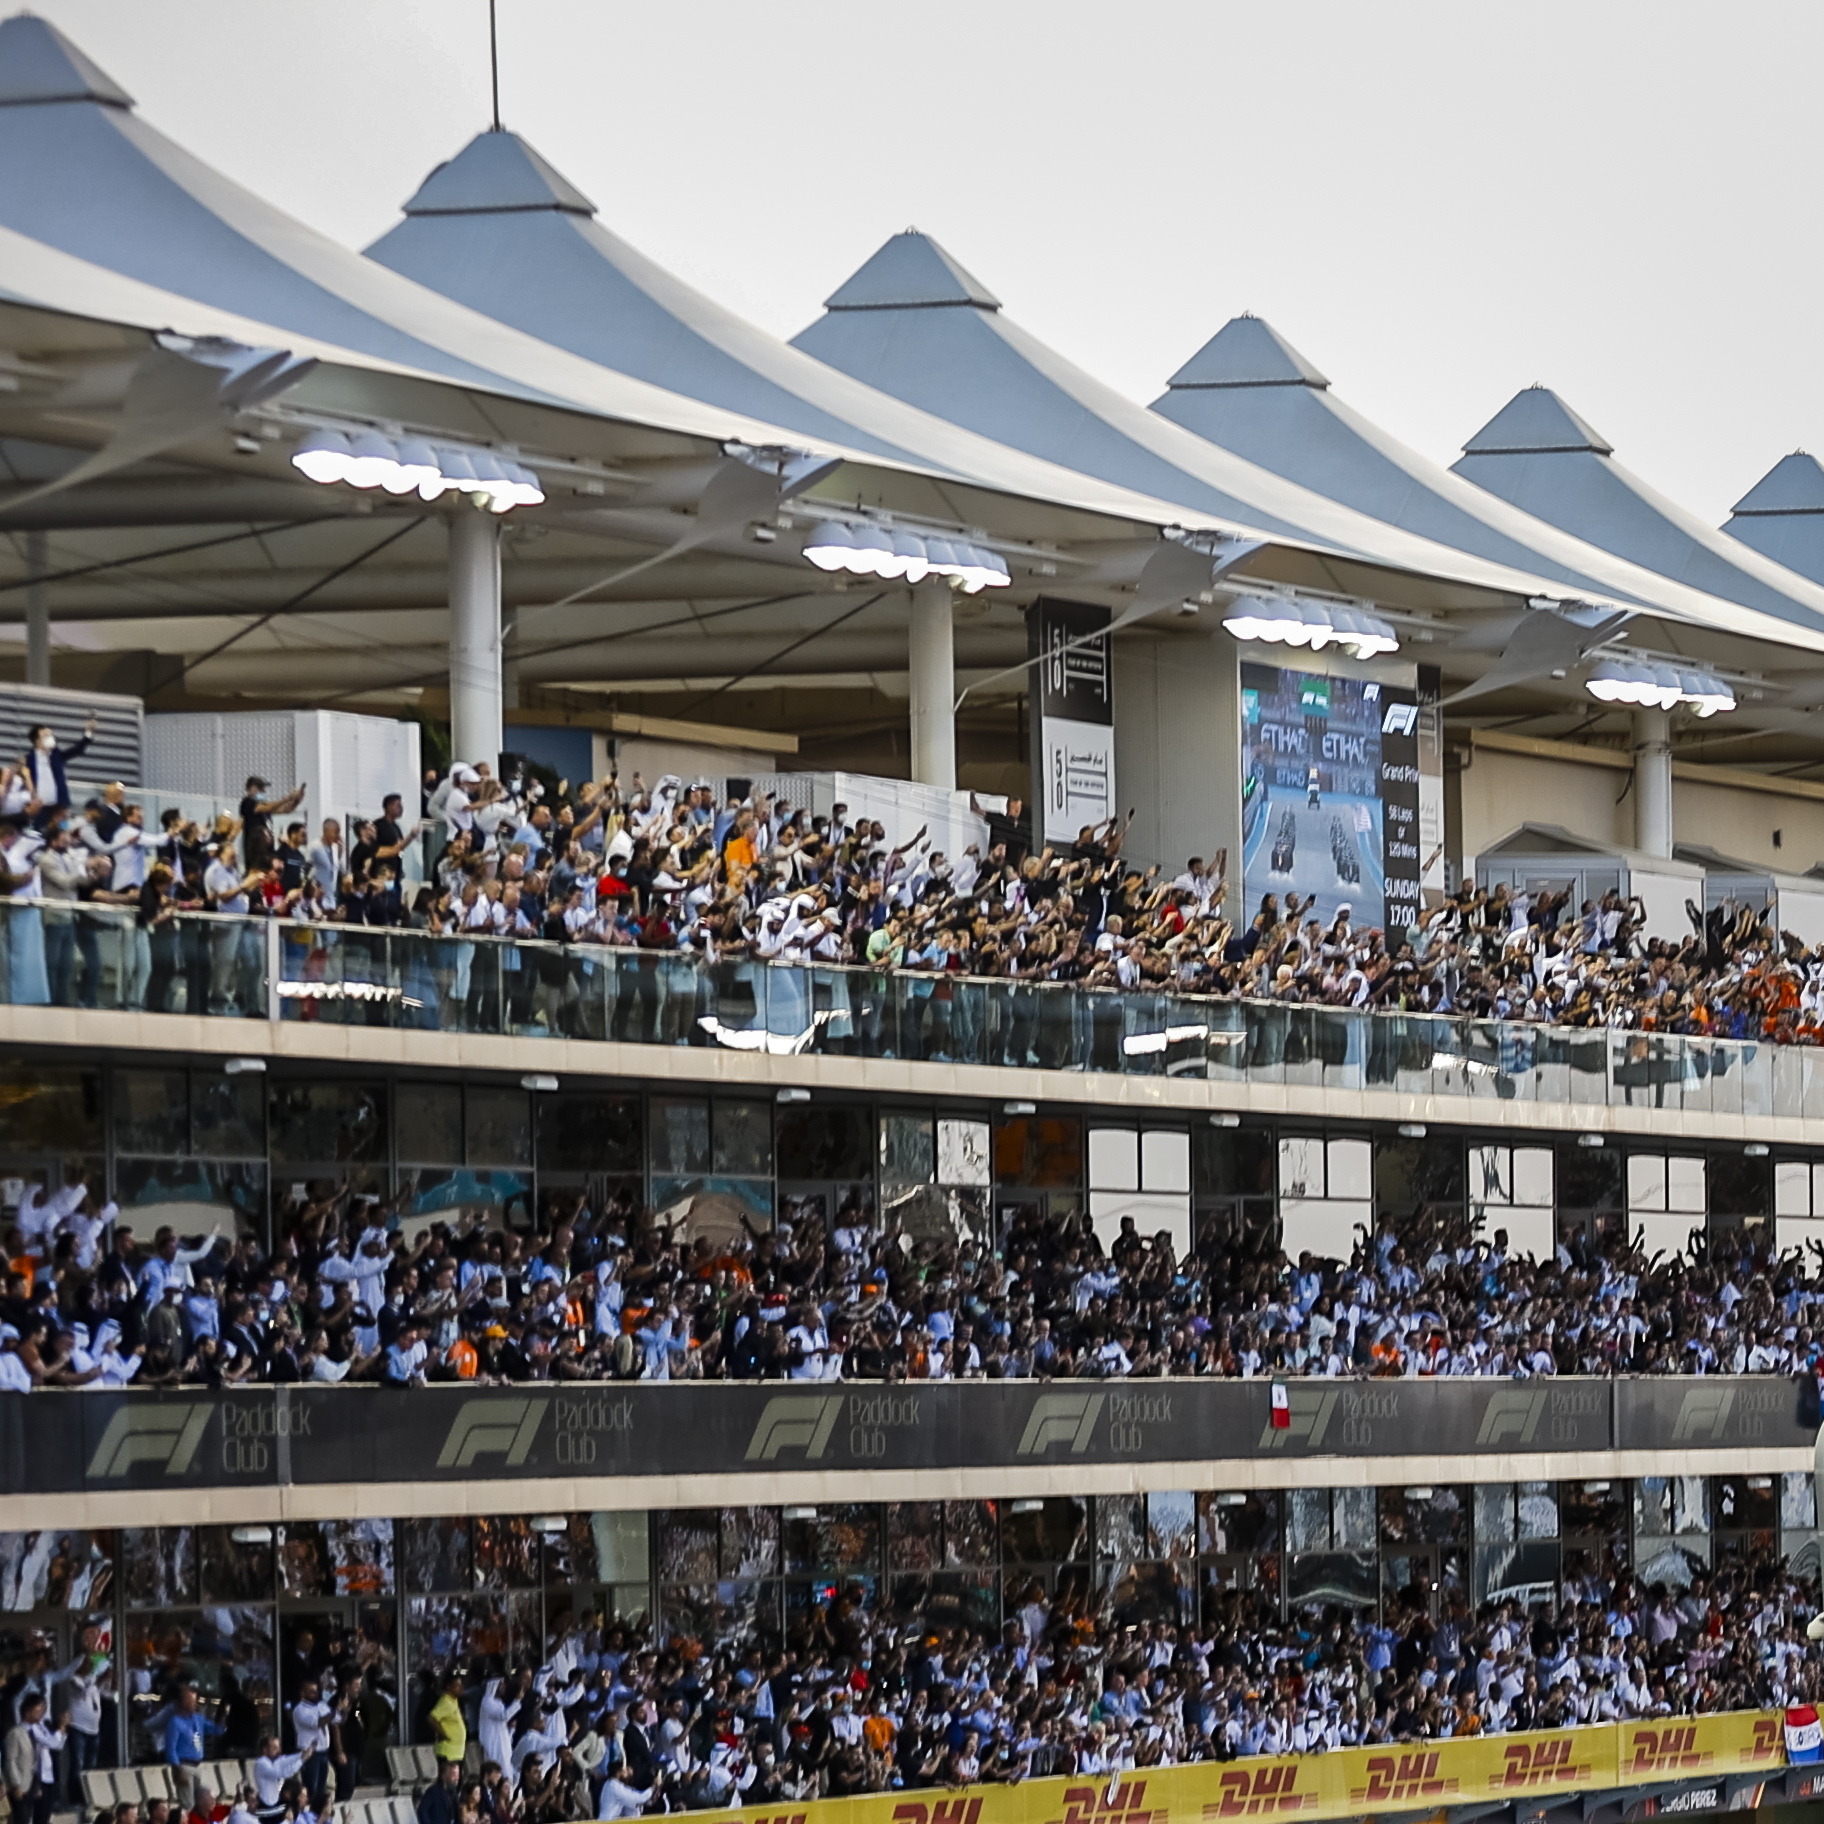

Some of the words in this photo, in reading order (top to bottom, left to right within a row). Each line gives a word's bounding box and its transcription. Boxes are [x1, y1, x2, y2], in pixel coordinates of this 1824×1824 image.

[1382, 761, 1403, 782] Grand
[1384, 876, 1419, 901] SUNDAY
[1389, 904, 1415, 928] 17:00
[222, 1401, 311, 1437] Paddock
[554, 1399, 633, 1431] Paddock
[849, 1394, 919, 1426] Paddock
[1109, 1393, 1172, 1423] Paddock
[1343, 1390, 1398, 1418] Paddock
[555, 1431, 596, 1465] Club
[850, 1426, 886, 1458] Club
[1110, 1423, 1142, 1453] Club
[1343, 1419, 1372, 1447] Club
[222, 1438, 268, 1473] Club
[1502, 1738, 1578, 1790] DHL
[1632, 1726, 1699, 1774] DHL
[1218, 1765, 1303, 1818] DHL
[1364, 1751, 1445, 1802] DHL
[1691, 1788, 1717, 1809] PEREZ
